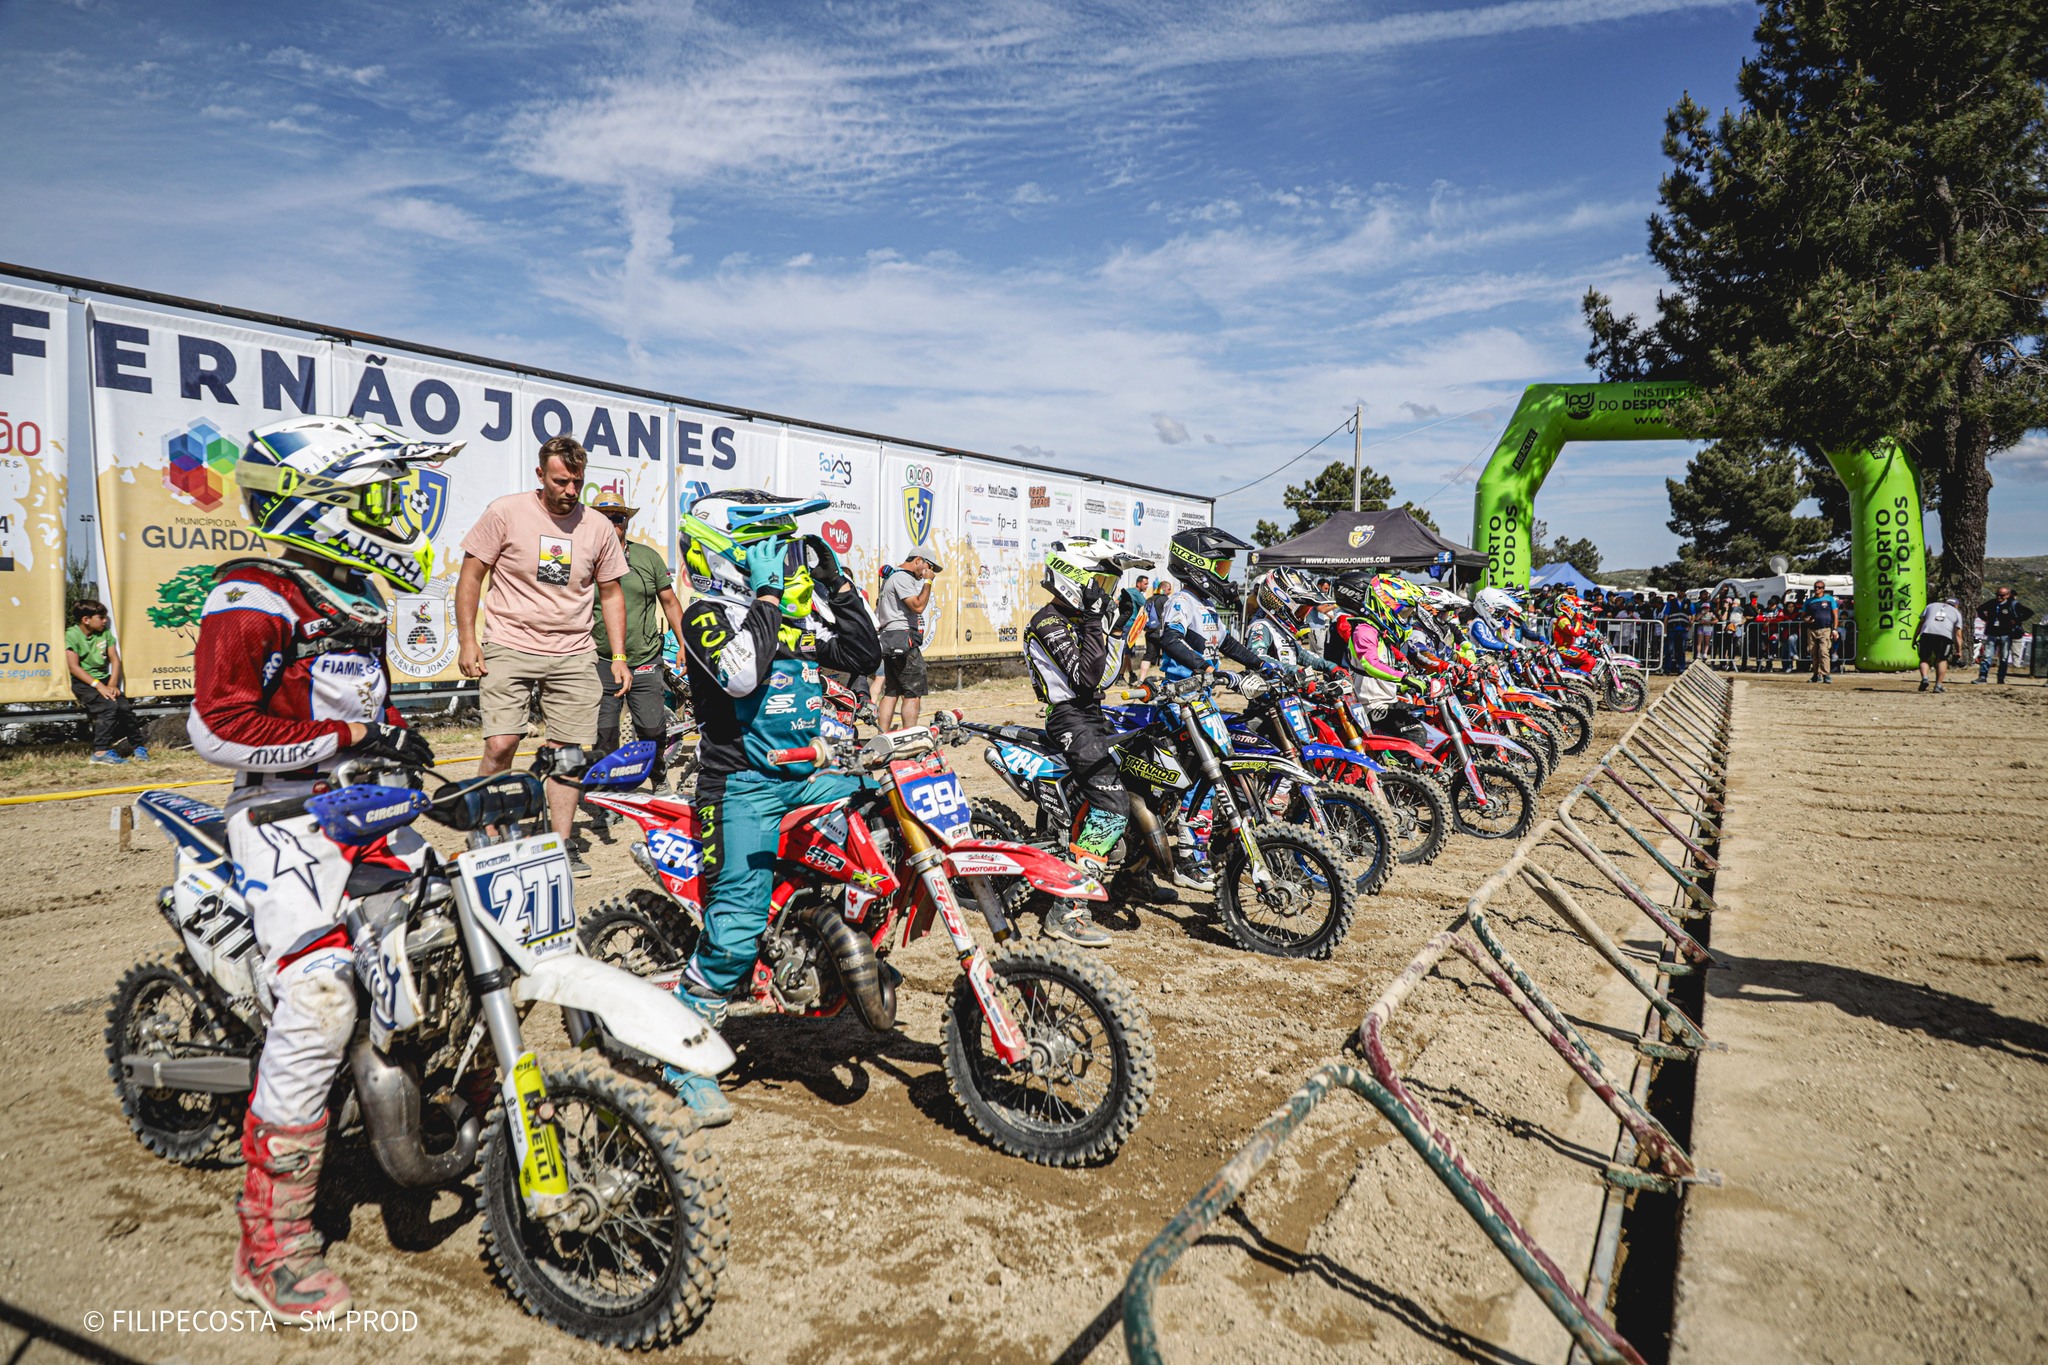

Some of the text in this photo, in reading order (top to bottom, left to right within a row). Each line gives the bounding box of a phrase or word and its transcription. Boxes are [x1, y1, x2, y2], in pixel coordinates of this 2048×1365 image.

[1599, 401, 1618, 410] DO
[481, 387, 737, 470] JOANES
[175, 517, 237, 527] MUNICÍPIO DA
[1113, 530, 1125, 540] TOP
[142, 525, 267, 551] GUARDA
[1876, 509, 1894, 629] DESPORTO
[1895, 496, 1912, 640] PARA TODOS
[7, 668, 51, 681] seguros
[389, 649, 455, 674] FERNÃO JOANES
[610, 763, 644, 778] CIRCUIT
[1003, 747, 1044, 782] 284
[365, 801, 411, 823] CIRCUIT
[911, 780, 969, 822] 394
[699, 805, 716, 865] FOX
[648, 834, 703, 876] 394
[489, 857, 575, 941] 277
[516, 1060, 532, 1071] elf
